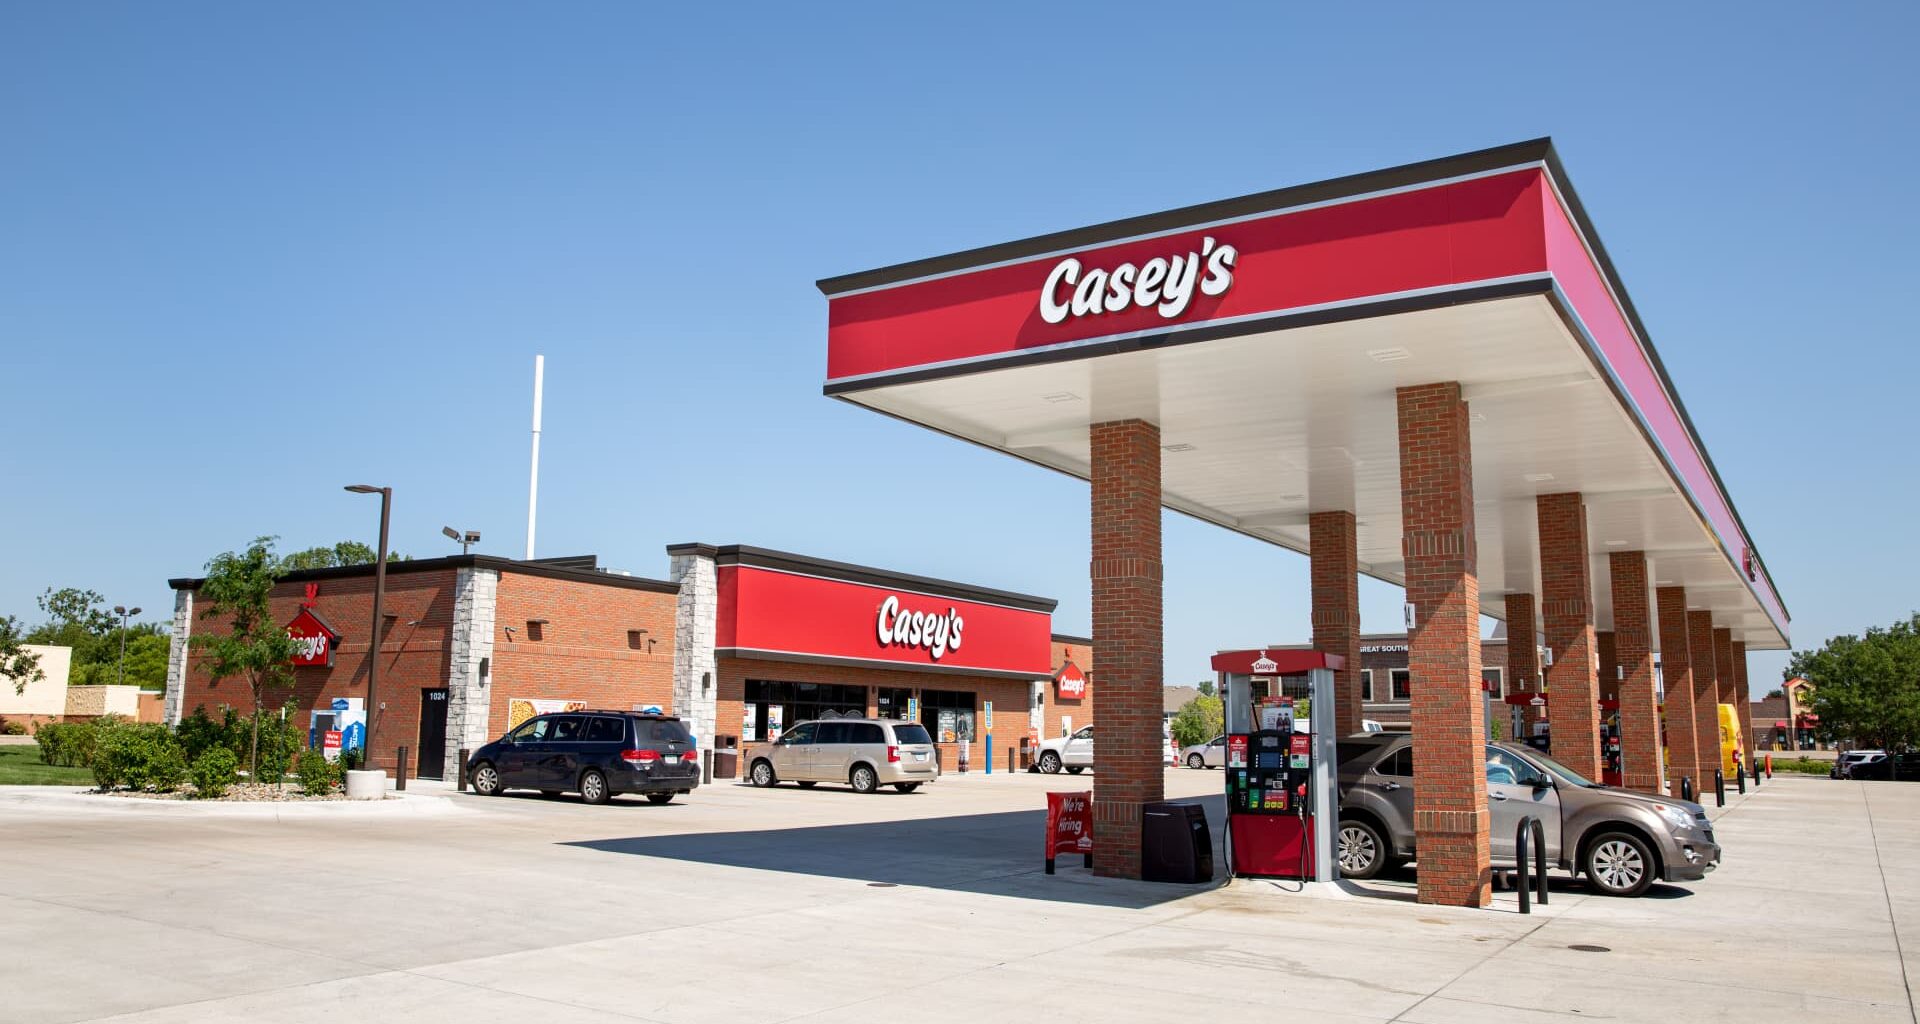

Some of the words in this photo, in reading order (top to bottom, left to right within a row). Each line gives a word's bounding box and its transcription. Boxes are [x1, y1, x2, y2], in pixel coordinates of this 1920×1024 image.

[1040, 237, 1237, 324] Casey's
[878, 596, 963, 659] Casey's
[287, 631, 326, 660] ey's
[1255, 662, 1275, 671] Casey's
[1060, 675, 1085, 695] Casey's
[430, 692, 446, 700] 1024
[1063, 797, 1084, 813] We're
[1058, 817, 1082, 835] Hiring
